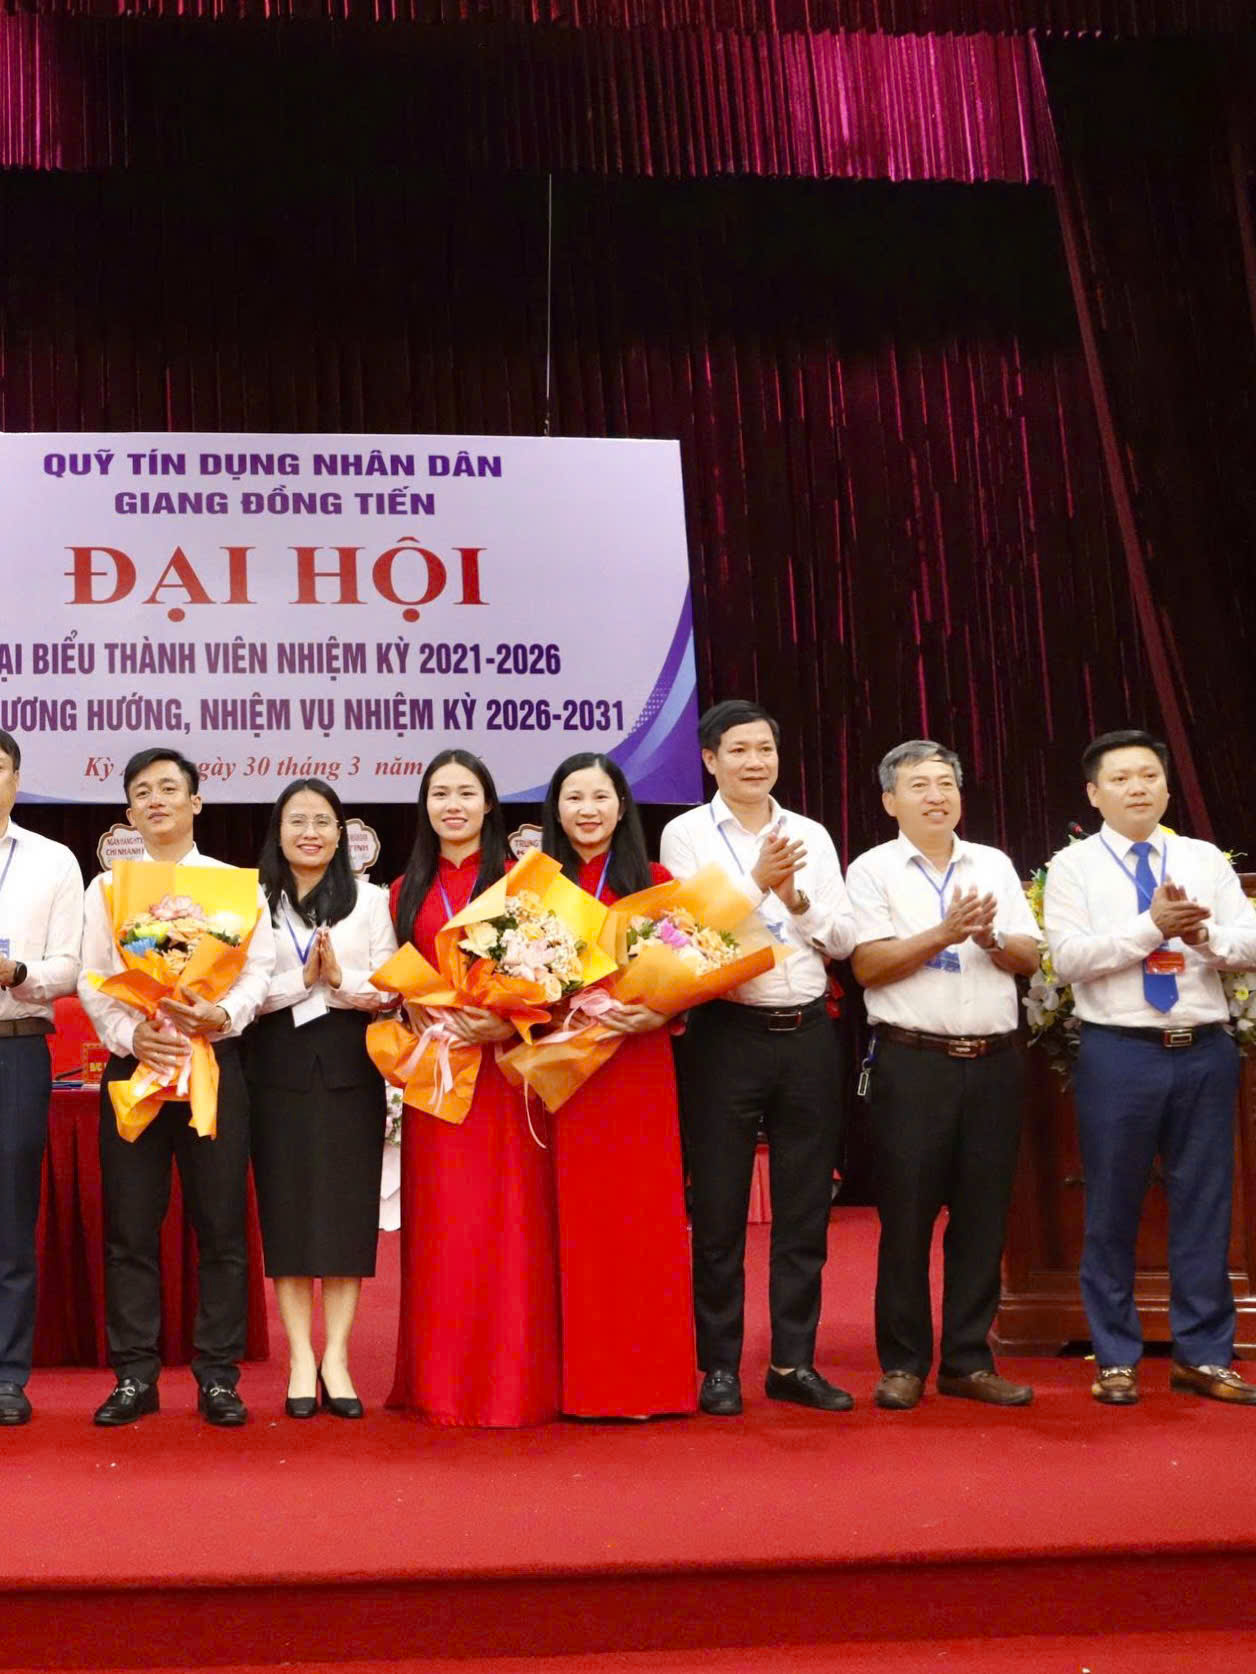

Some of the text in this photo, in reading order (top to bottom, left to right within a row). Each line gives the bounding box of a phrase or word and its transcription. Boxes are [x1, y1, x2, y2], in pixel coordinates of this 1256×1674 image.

[44, 449, 501, 480] QUỸ TÍN DỤNG NHÂN DÂN
[114, 484, 435, 515] GIANG ĐỒNG TIẾN
[64, 536, 490, 623] ĐẠI HỘI
[33, 630, 95, 675] BIỂU
[104, 636, 195, 674] THÀNH
[205, 636, 267, 674] VIÊN
[277, 636, 366, 681] NHIỆM
[377, 636, 410, 674] KỲ
[420, 643, 561, 675] 2021-2026
[87, 692, 191, 735] HƯỚNG,
[200, 692, 290, 737] NHIỆM
[300, 699, 335, 738] VỤ
[344, 692, 434, 737] NHIỆM
[443, 692, 477, 731] KỲ
[486, 699, 624, 731] 2026-2031
[84, 756, 114, 782] Kỳ
[197, 756, 236, 781] gày
[243, 756, 271, 776] 30
[277, 756, 341, 780] tháng
[348, 756, 361, 776] 3
[375, 757, 423, 776] năm
